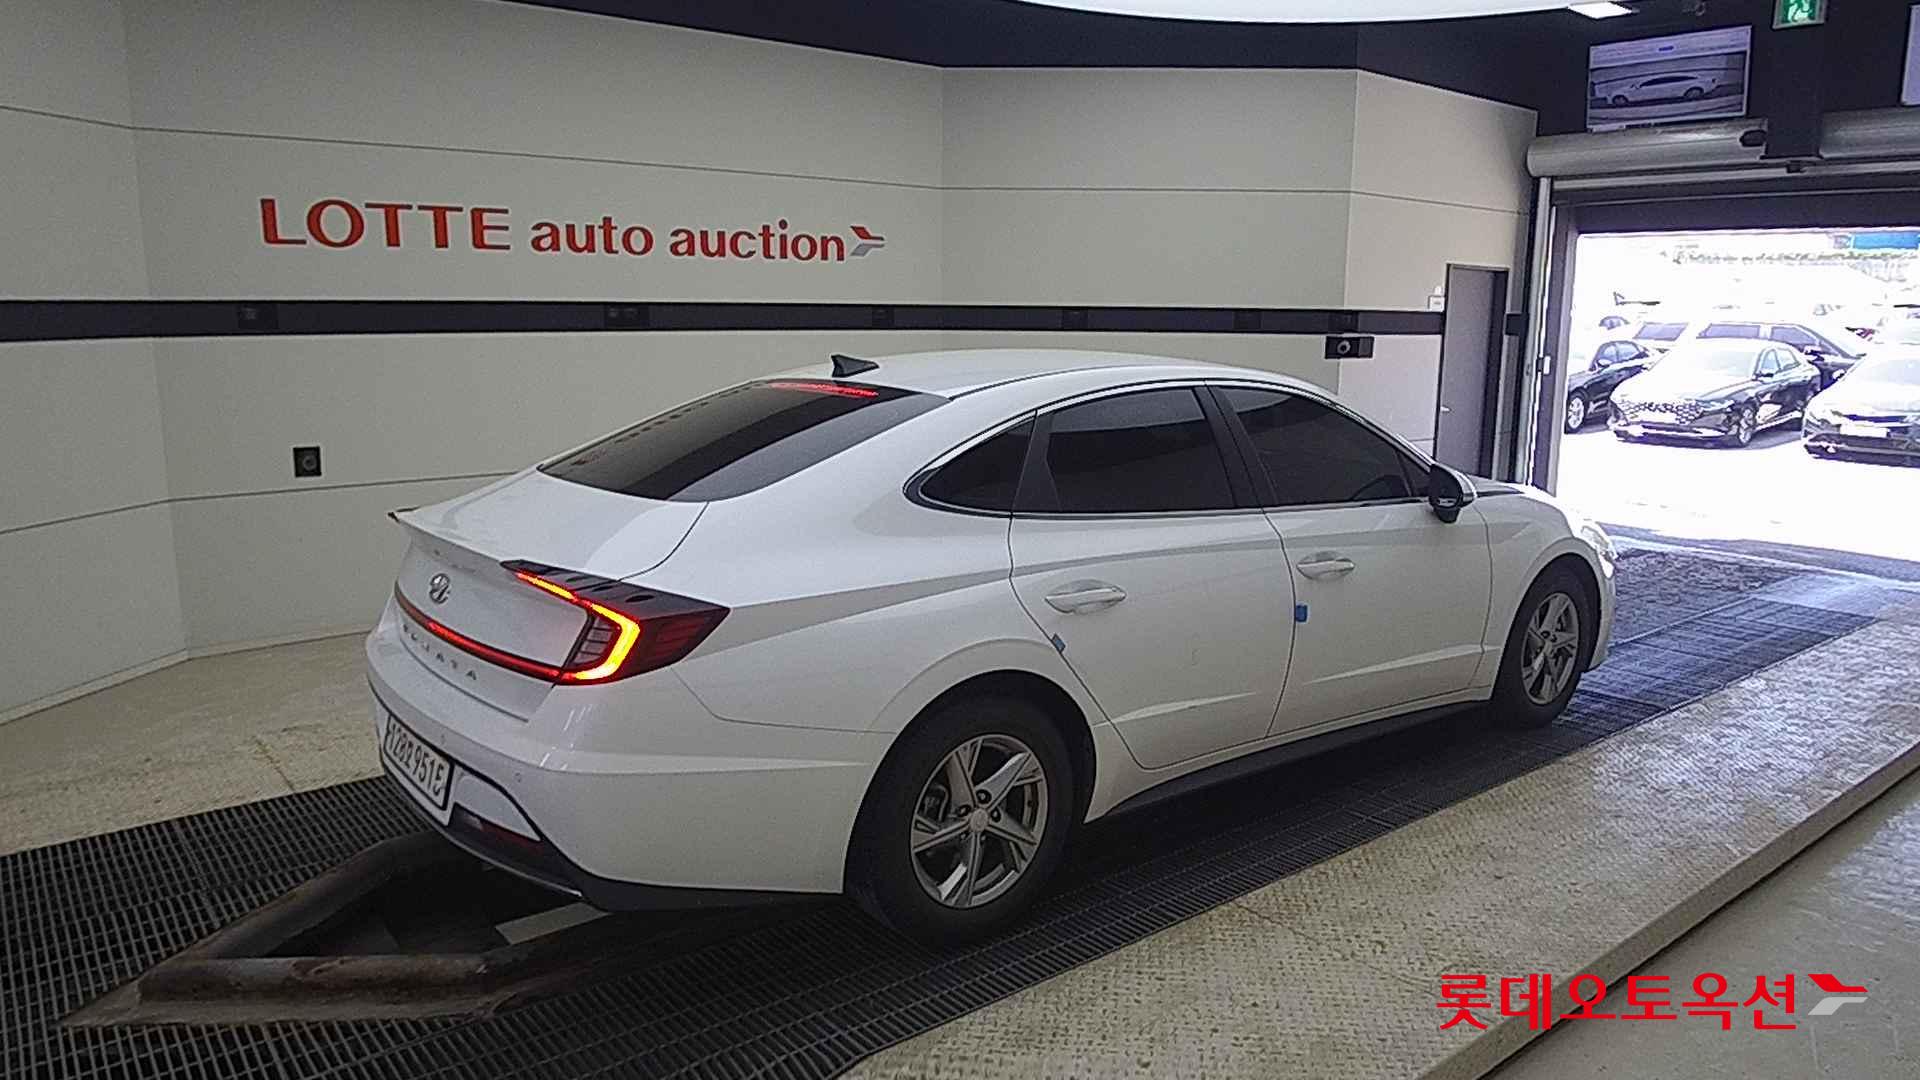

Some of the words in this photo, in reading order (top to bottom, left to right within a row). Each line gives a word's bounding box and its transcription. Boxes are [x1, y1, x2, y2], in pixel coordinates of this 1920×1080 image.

[259, 198, 511, 252] LOTTE
[531, 215, 655, 256] auto
[669, 219, 847, 262] auction
